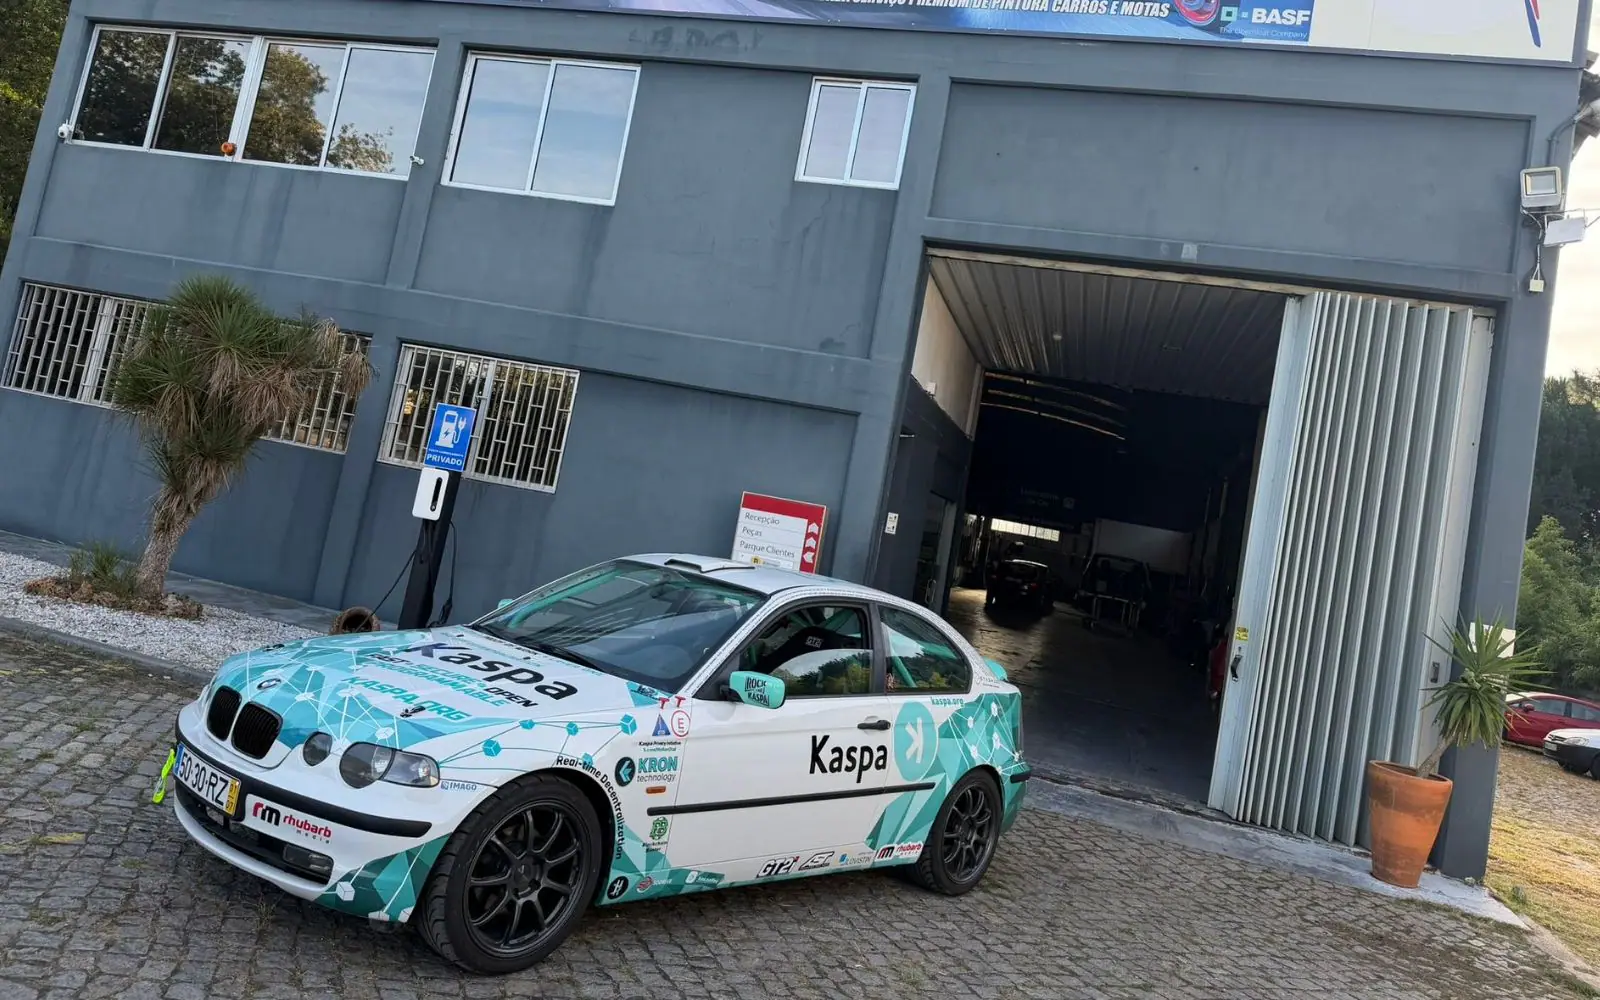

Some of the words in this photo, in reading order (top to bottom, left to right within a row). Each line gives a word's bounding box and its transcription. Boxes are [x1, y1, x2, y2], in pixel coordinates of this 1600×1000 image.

[970, 0, 989, 9] DE
[988, 0, 1049, 12] PINTURA
[1051, 0, 1108, 15] CARROS
[1109, 3, 1118, 15] E
[1119, 3, 1171, 18] MOTAS
[1251, 7, 1312, 26] BASF
[426, 453, 463, 466] PRIVADO
[744, 511, 780, 525] Recepção
[742, 526, 762, 537] Peças
[739, 540, 765, 552] Parque
[765, 545, 795, 558] Clientes
[398, 641, 579, 701] Kaspa
[484, 686, 539, 708] OPEN
[930, 697, 964, 708] kaspa.org
[637, 756, 678, 774] KRON
[808, 734, 888, 783] Kaspa
[449, 781, 477, 791] IMAGO
[636, 774, 676, 782] technology
[556, 755, 601, 778] Real-time
[599, 773, 626, 860] Decentralization
[283, 814, 332, 838] rhubarb
